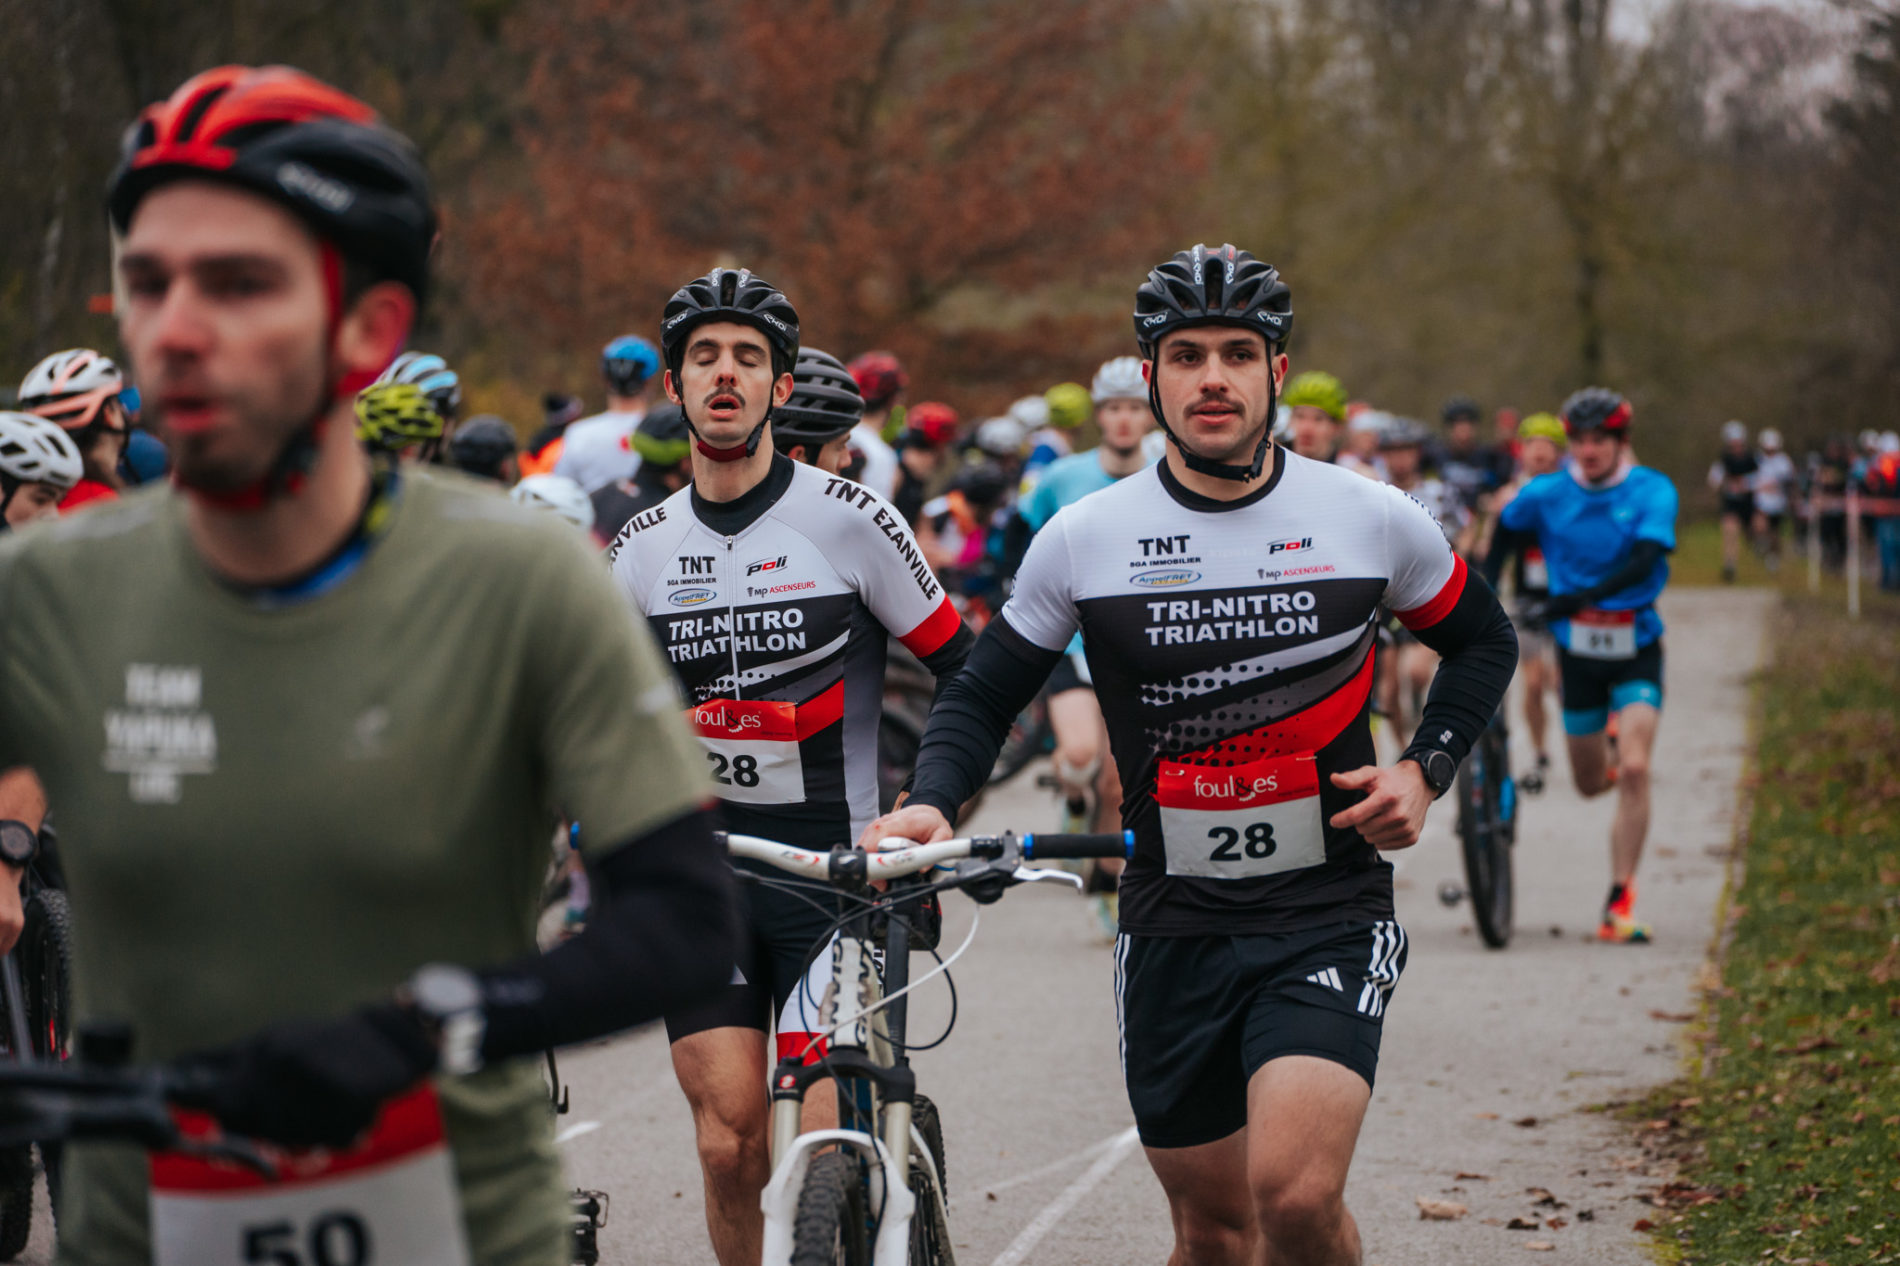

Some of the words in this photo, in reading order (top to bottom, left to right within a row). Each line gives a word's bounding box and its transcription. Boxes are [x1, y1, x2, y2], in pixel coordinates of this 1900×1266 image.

[609, 507, 667, 562] NVILLE
[824, 478, 877, 510] TNT
[872, 507, 939, 601] EZANVILLE
[1138, 535, 1191, 556] TNT
[678, 556, 716, 575] TNT
[1149, 557, 1202, 567] IMMOBILIER
[1283, 565, 1335, 577] ASCENSEURS
[667, 579, 679, 587] SGA
[680, 577, 717, 585] IMMOBILIER
[769, 580, 817, 594] ASCENSEURS
[1146, 590, 1316, 623] TRI-NITRO
[668, 607, 804, 641] TRI-NITRO
[1145, 615, 1319, 646] TRIATHLON
[667, 631, 807, 663] TRIATHLON
[706, 751, 760, 788] 28
[1207, 822, 1277, 862] 28
[241, 1210, 372, 1266] 50
